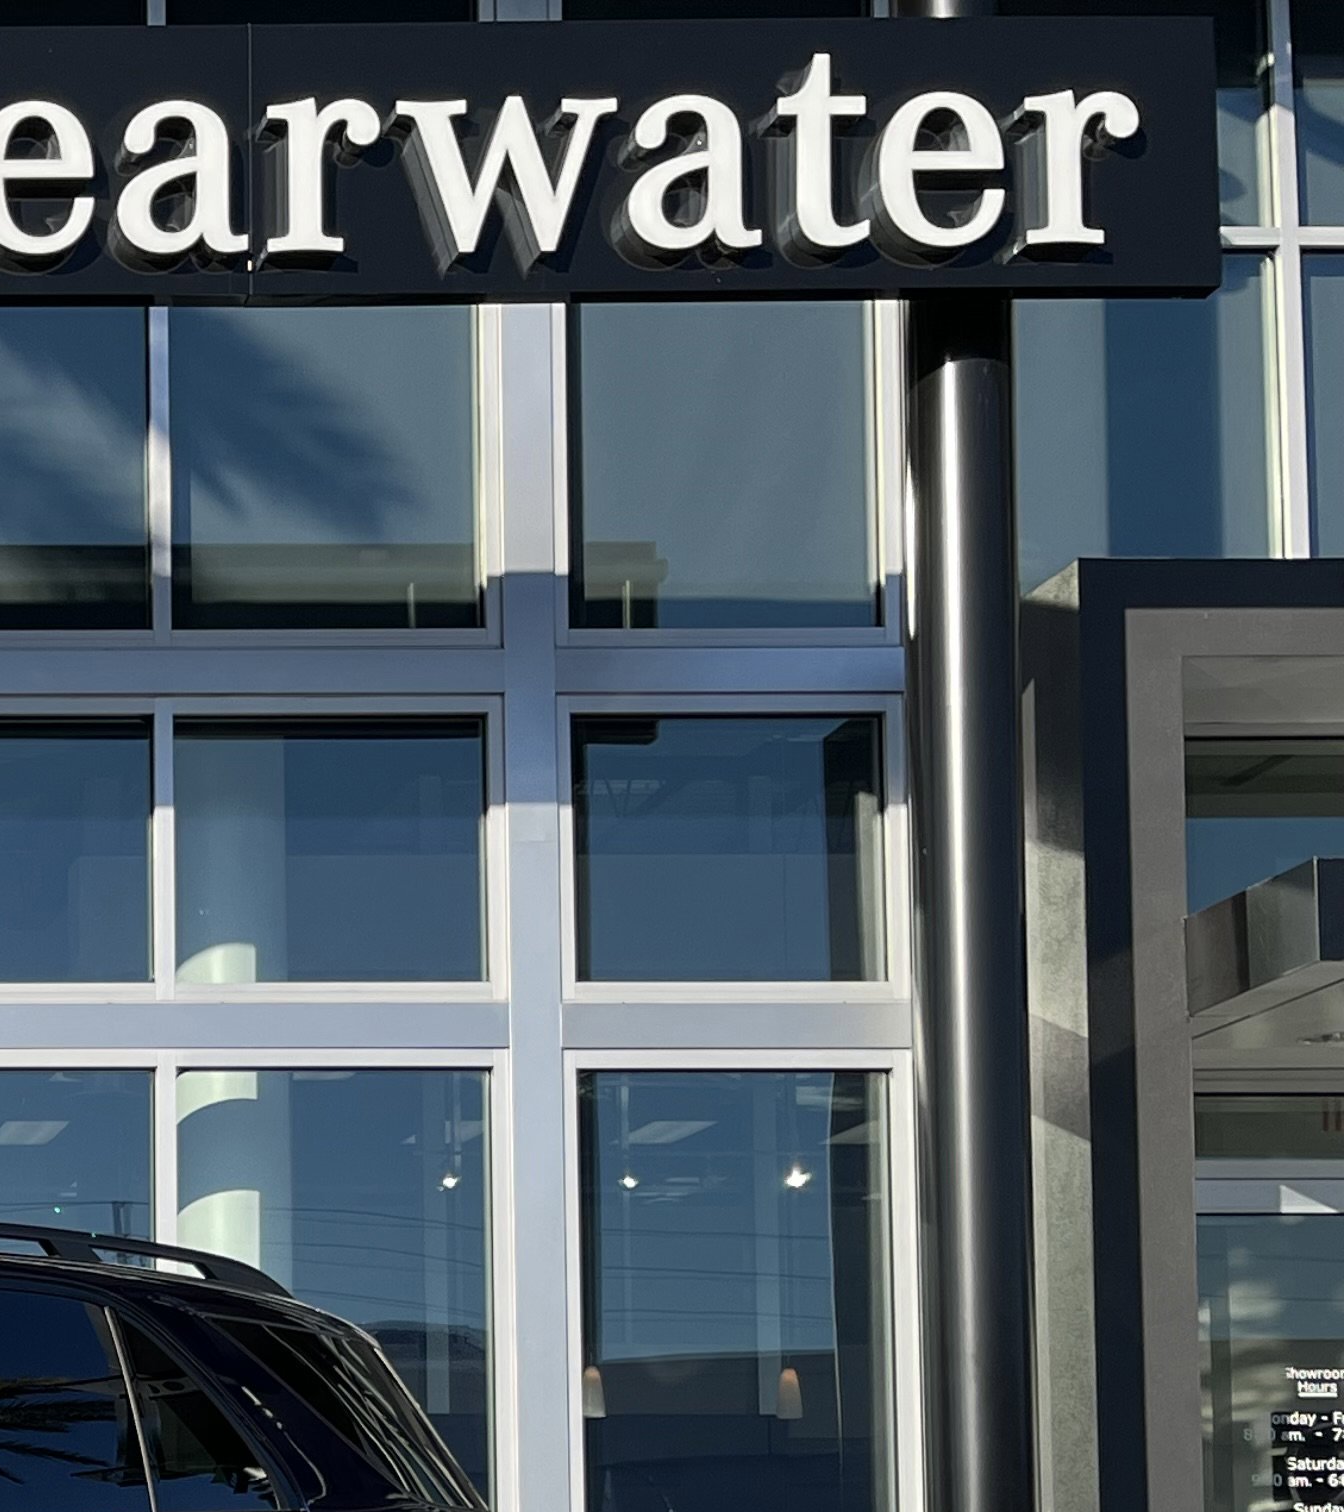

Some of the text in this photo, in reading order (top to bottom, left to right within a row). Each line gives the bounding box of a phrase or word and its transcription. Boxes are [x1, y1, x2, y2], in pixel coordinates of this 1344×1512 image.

[1297, 1381, 1338, 1392] Hours
[1272, 1411, 1317, 1427] onday
[1287, 1456, 1344, 1471] Saturda
